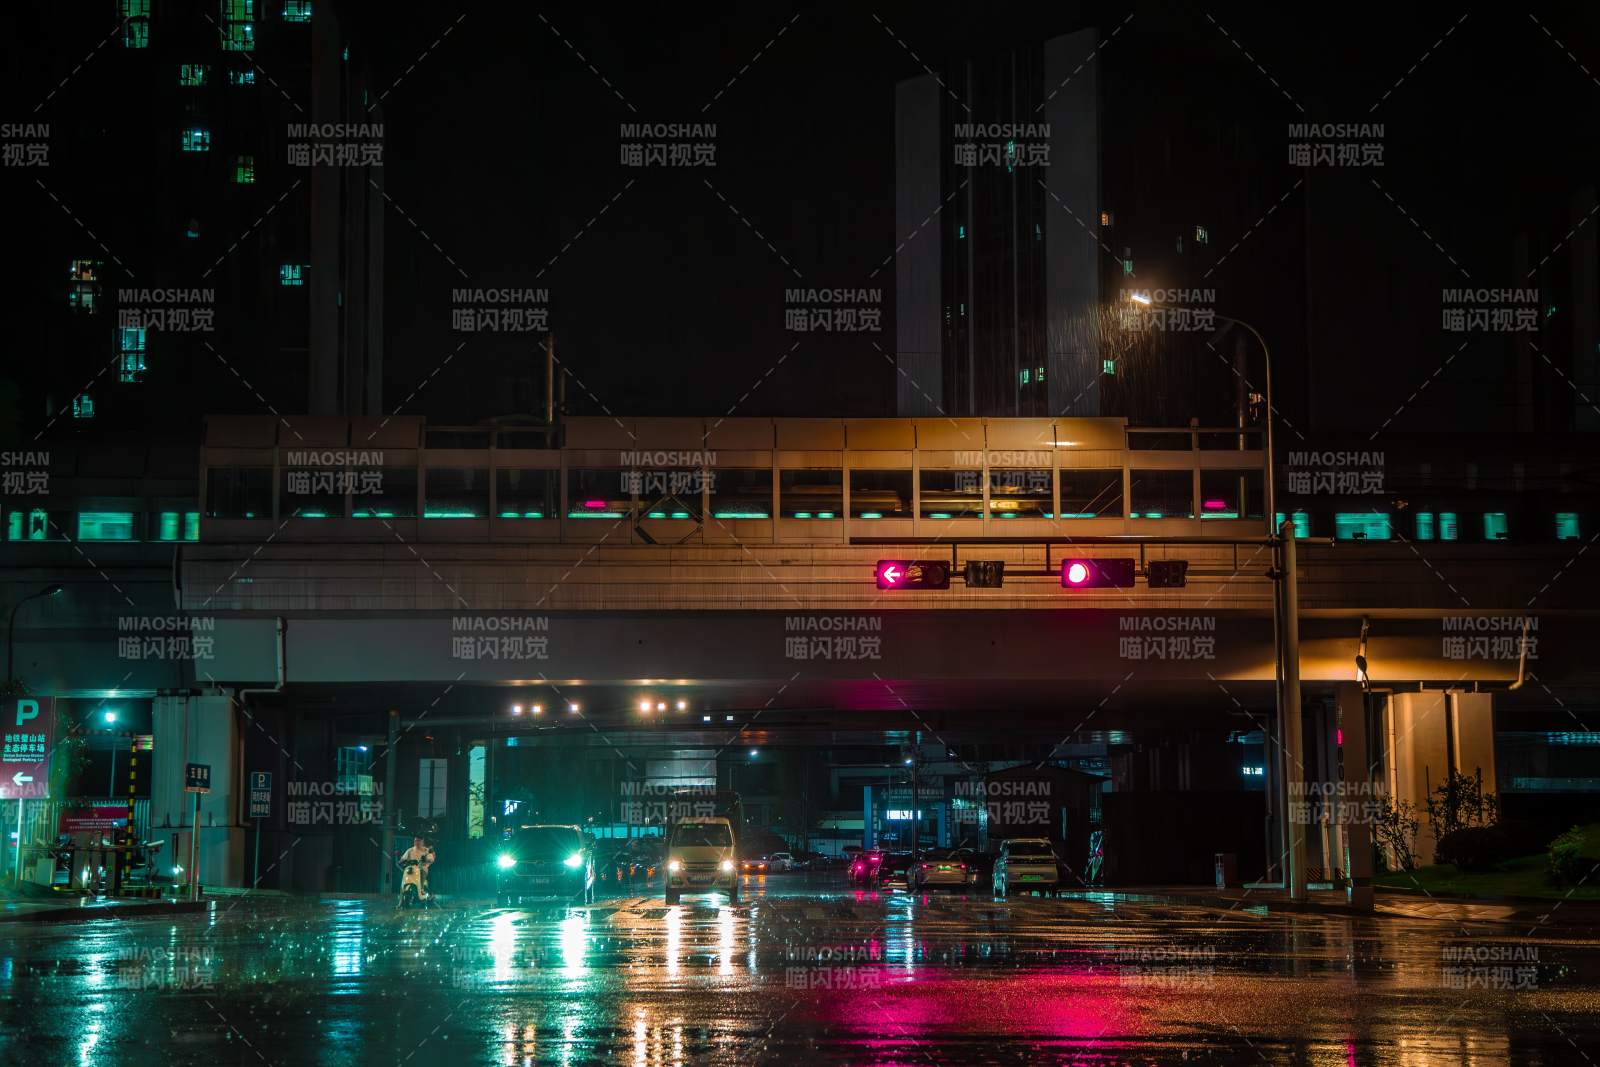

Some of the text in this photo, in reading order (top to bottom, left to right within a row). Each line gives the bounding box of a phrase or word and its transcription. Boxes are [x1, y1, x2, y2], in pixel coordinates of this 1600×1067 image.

[16, 699, 39, 726] P
[4, 743, 45, 753] 生态停车场
[258, 774, 266, 788] P
